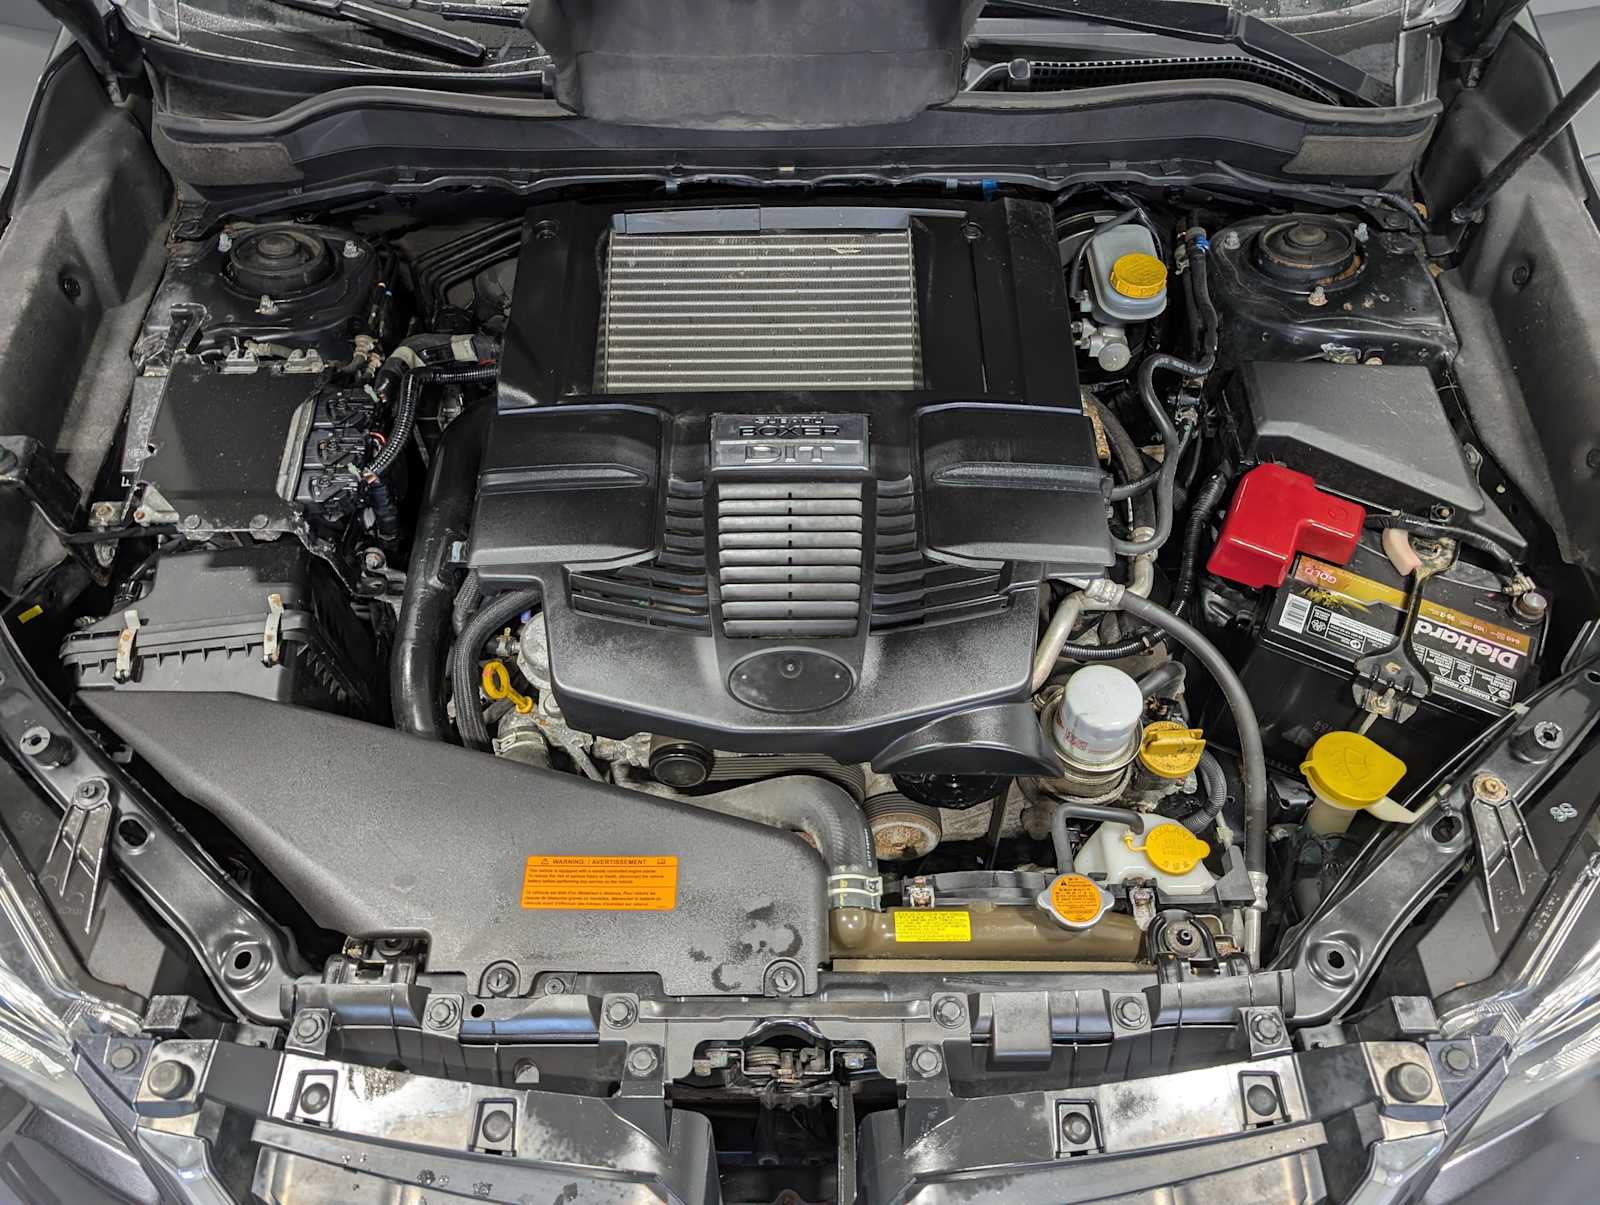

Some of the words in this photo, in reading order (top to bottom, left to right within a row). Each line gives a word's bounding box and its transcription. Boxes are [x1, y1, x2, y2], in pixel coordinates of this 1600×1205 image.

[739, 425, 840, 436] BOXER
[744, 445, 836, 463] DIT
[1304, 566, 1337, 584] GOLD
[1413, 620, 1521, 669] DieHard
